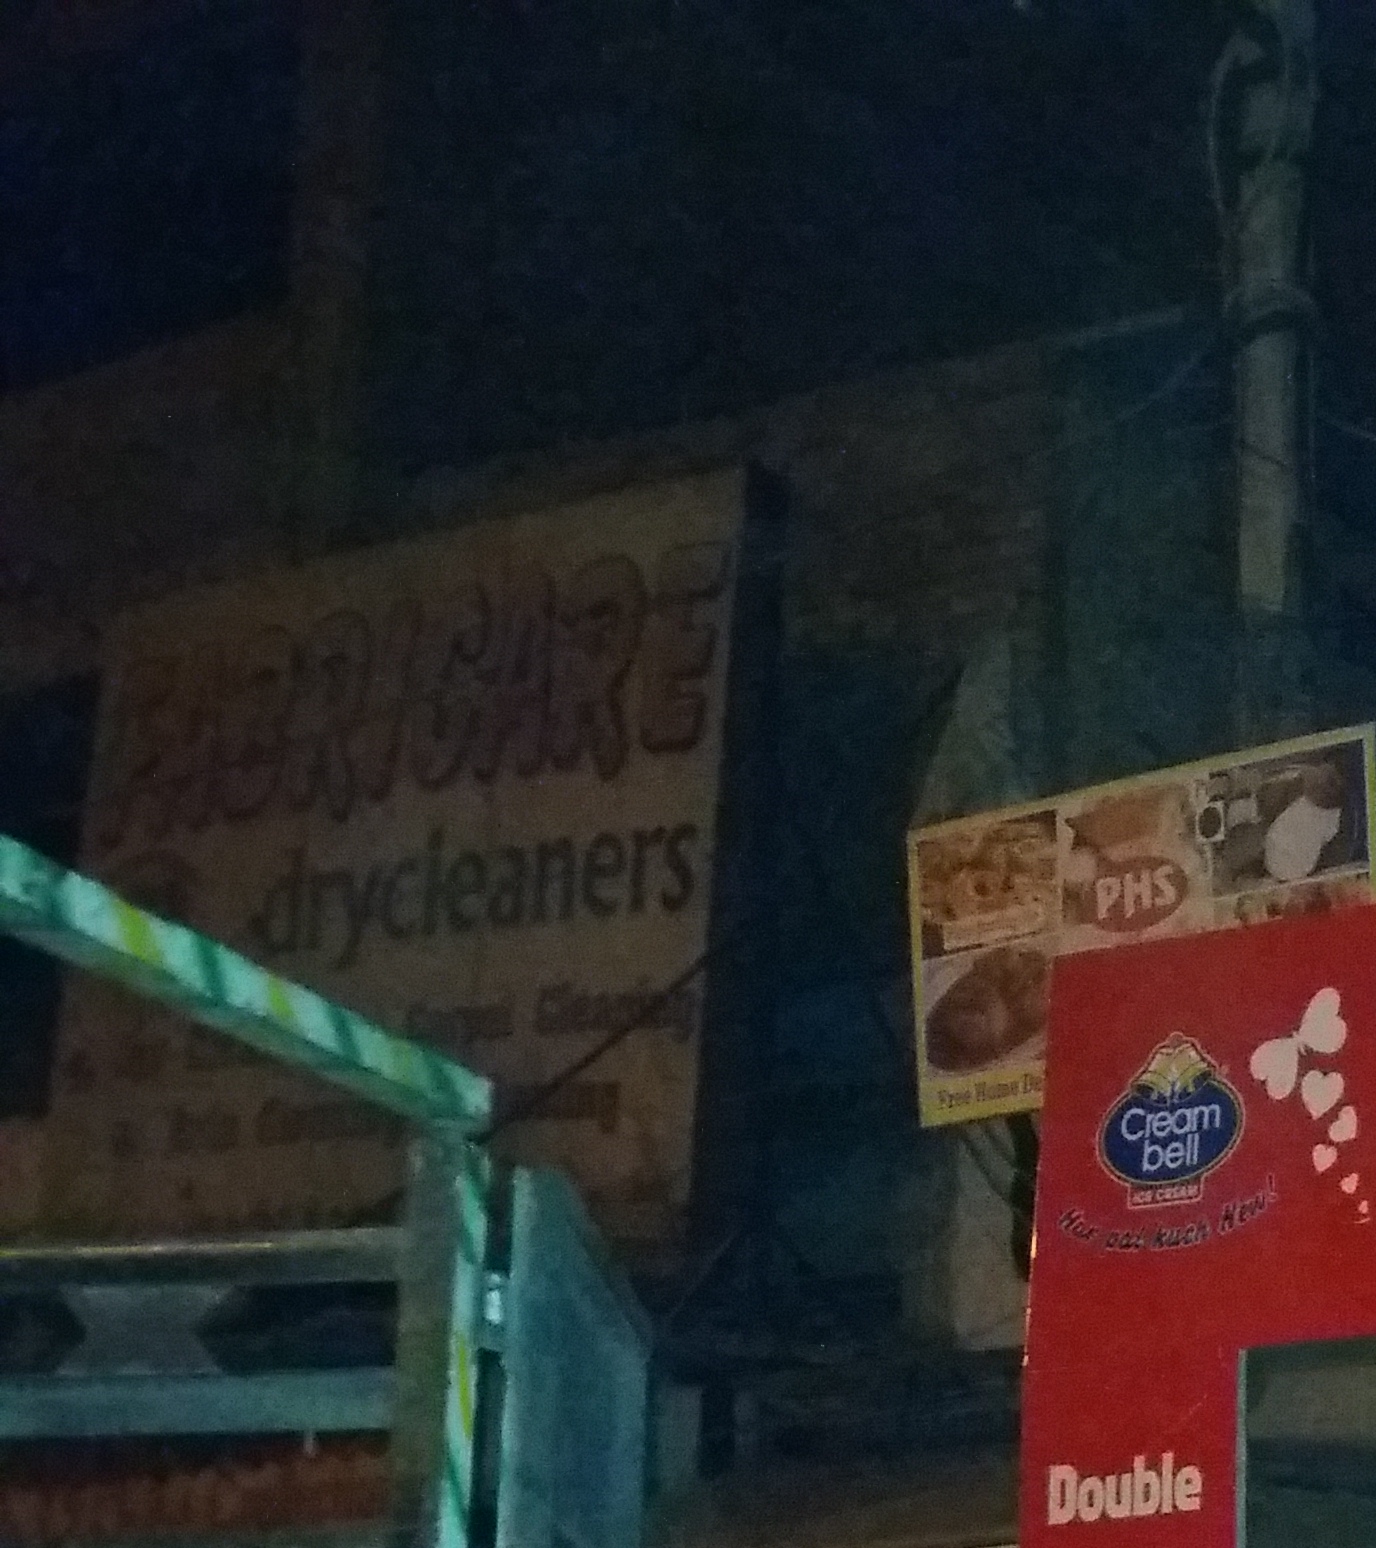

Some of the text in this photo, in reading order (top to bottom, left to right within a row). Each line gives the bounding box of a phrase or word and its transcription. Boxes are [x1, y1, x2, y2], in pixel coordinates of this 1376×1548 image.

[262, 822, 699, 970] drycleaners
[1094, 865, 1177, 920] PHS
[1120, 1102, 1221, 1142] Cream
[1141, 1133, 1200, 1172] bell
[1047, 1450, 1204, 1527] Double
